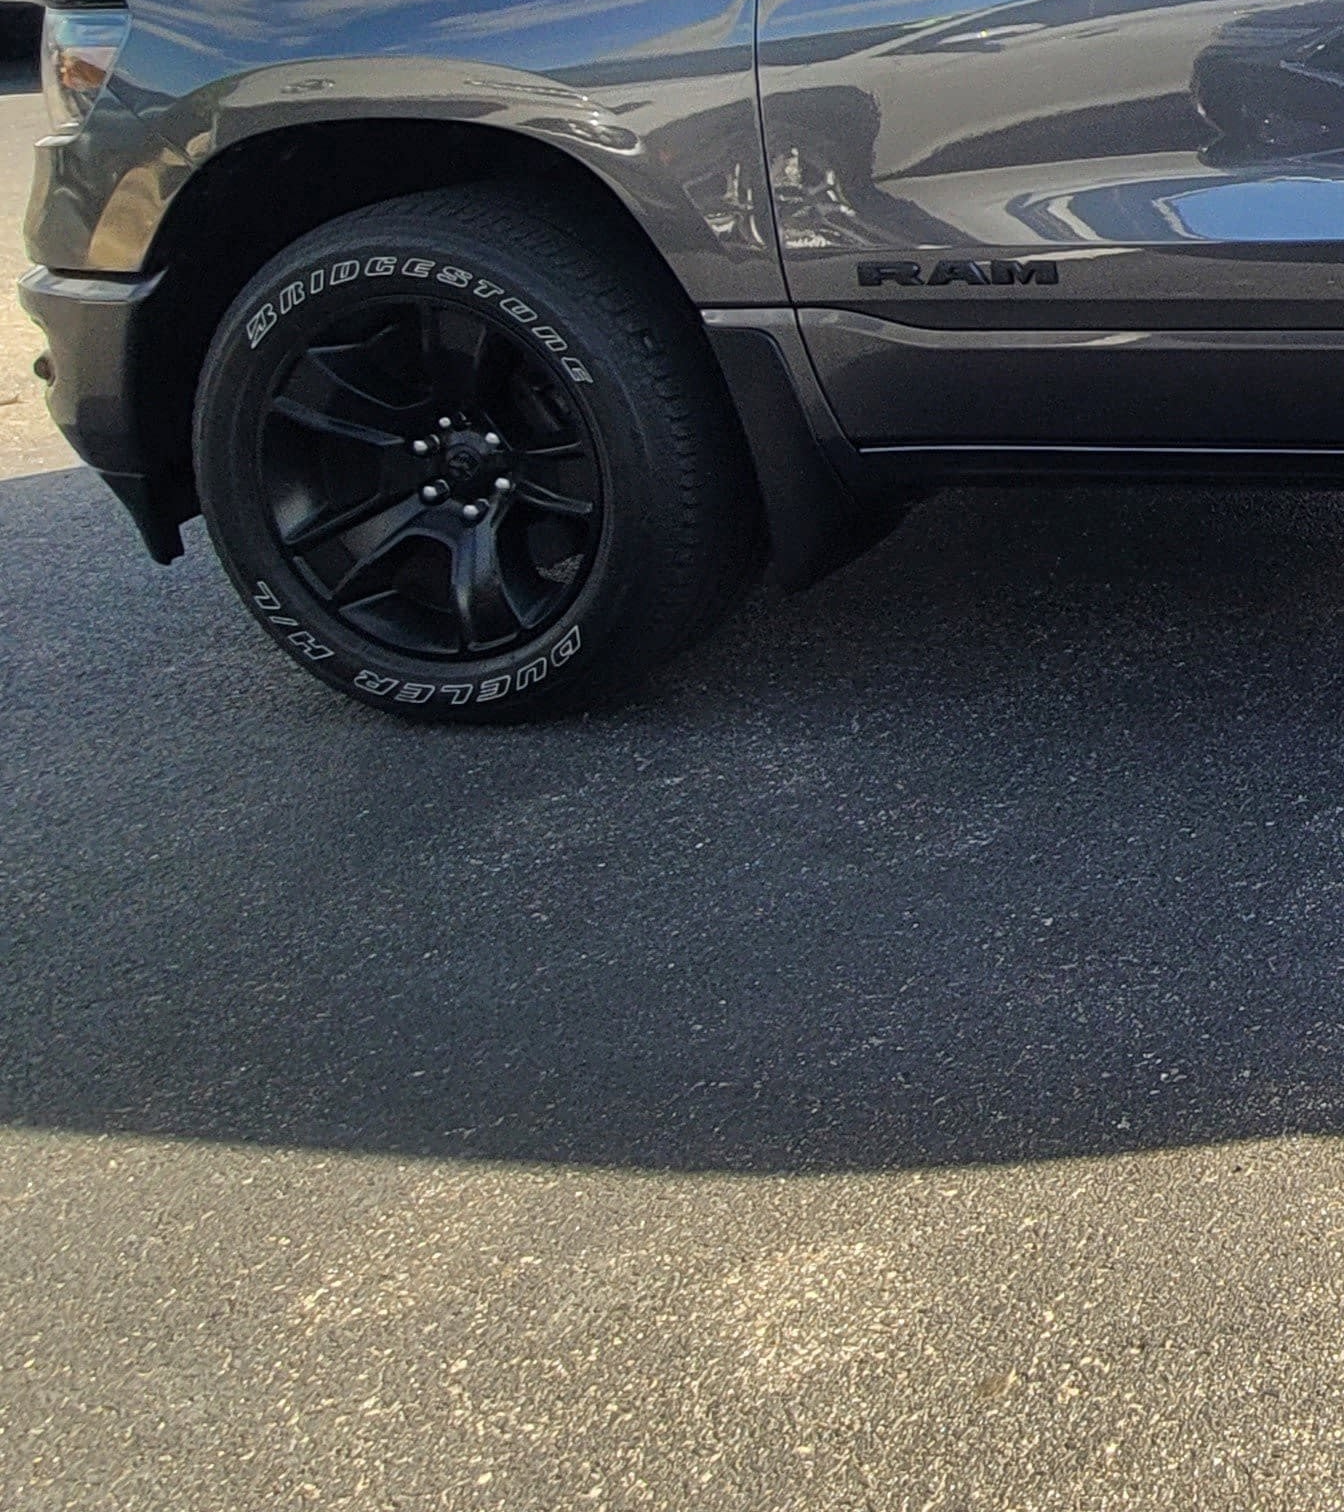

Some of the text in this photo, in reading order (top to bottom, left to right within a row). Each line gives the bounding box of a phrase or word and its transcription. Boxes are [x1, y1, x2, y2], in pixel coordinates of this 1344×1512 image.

[857, 259, 1059, 286] RAM
[246, 256, 594, 384] BRIDGESTONE
[354, 625, 582, 705] DUELER
